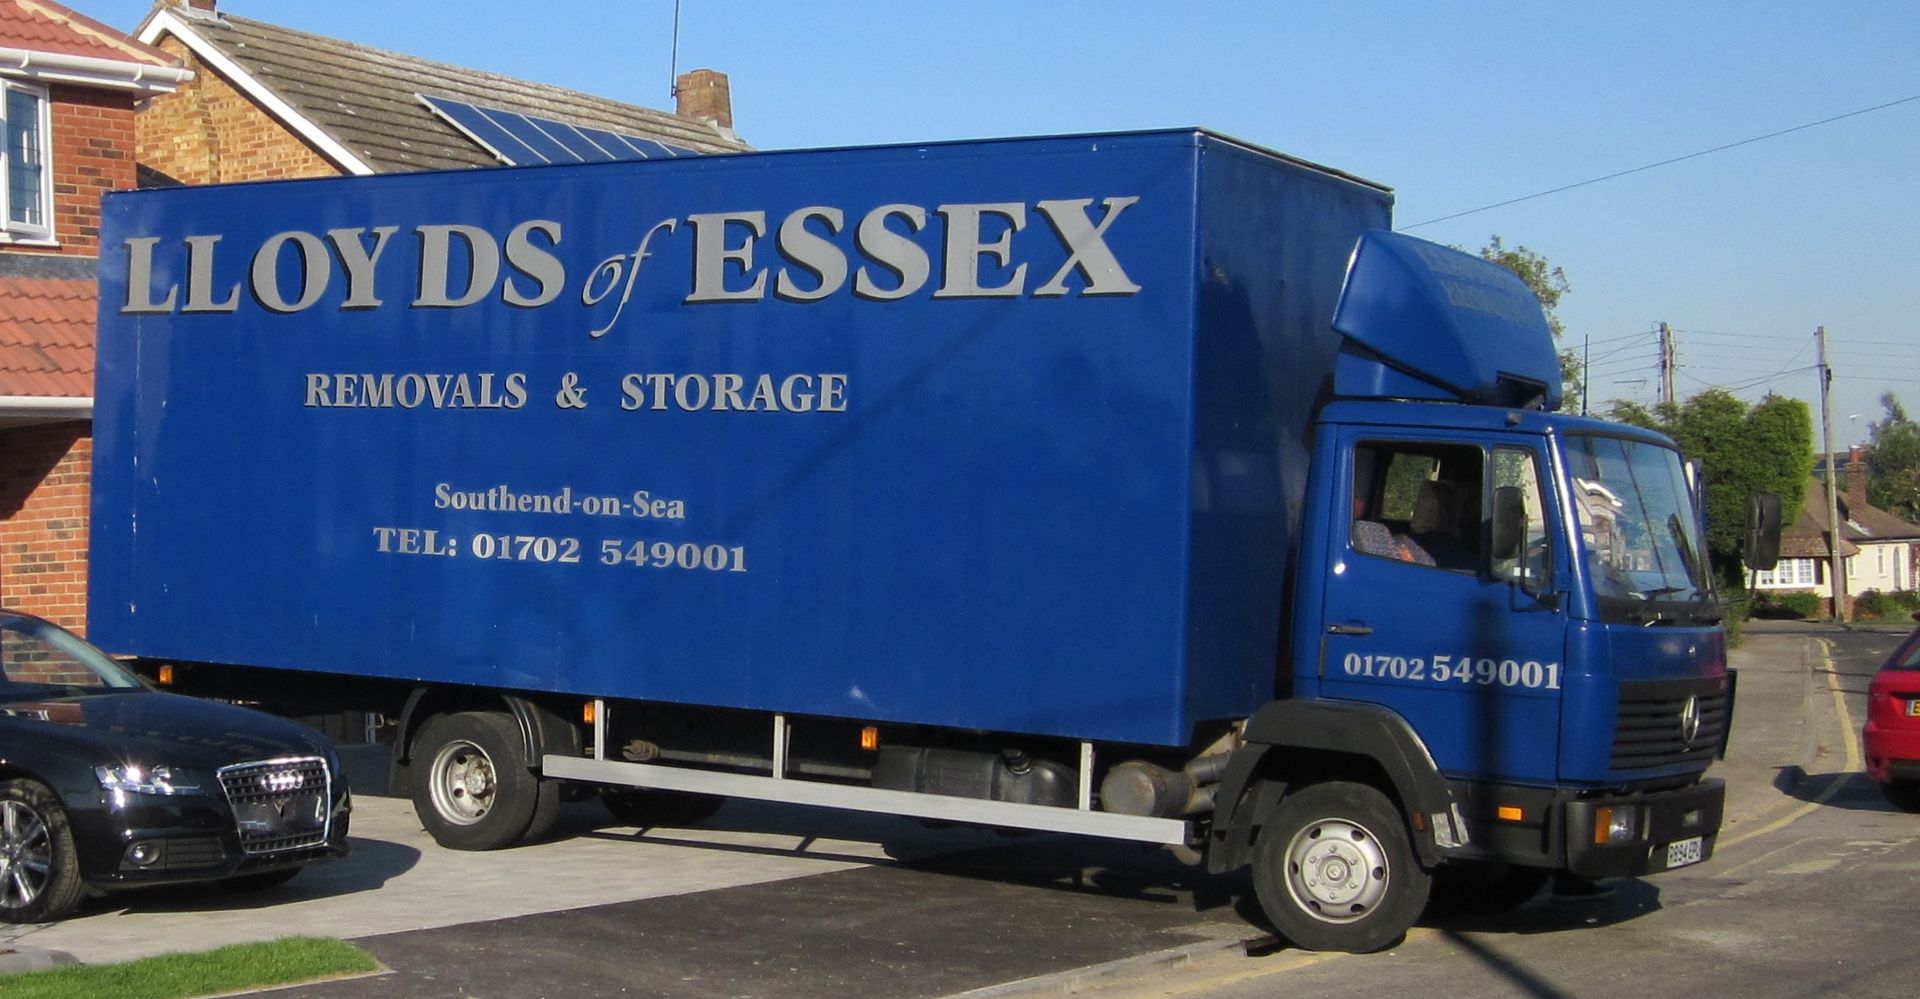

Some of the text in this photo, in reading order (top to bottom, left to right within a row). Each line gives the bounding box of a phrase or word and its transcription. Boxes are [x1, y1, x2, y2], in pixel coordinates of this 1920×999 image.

[120, 196, 1142, 338] LLOYDS of ESSEX
[304, 371, 847, 412] REMOVALS & STORAGE
[434, 482, 685, 519] Southend-on-Sea
[373, 527, 747, 572] TEL: 01702 549001
[1344, 653, 1561, 689] 01702 549001
